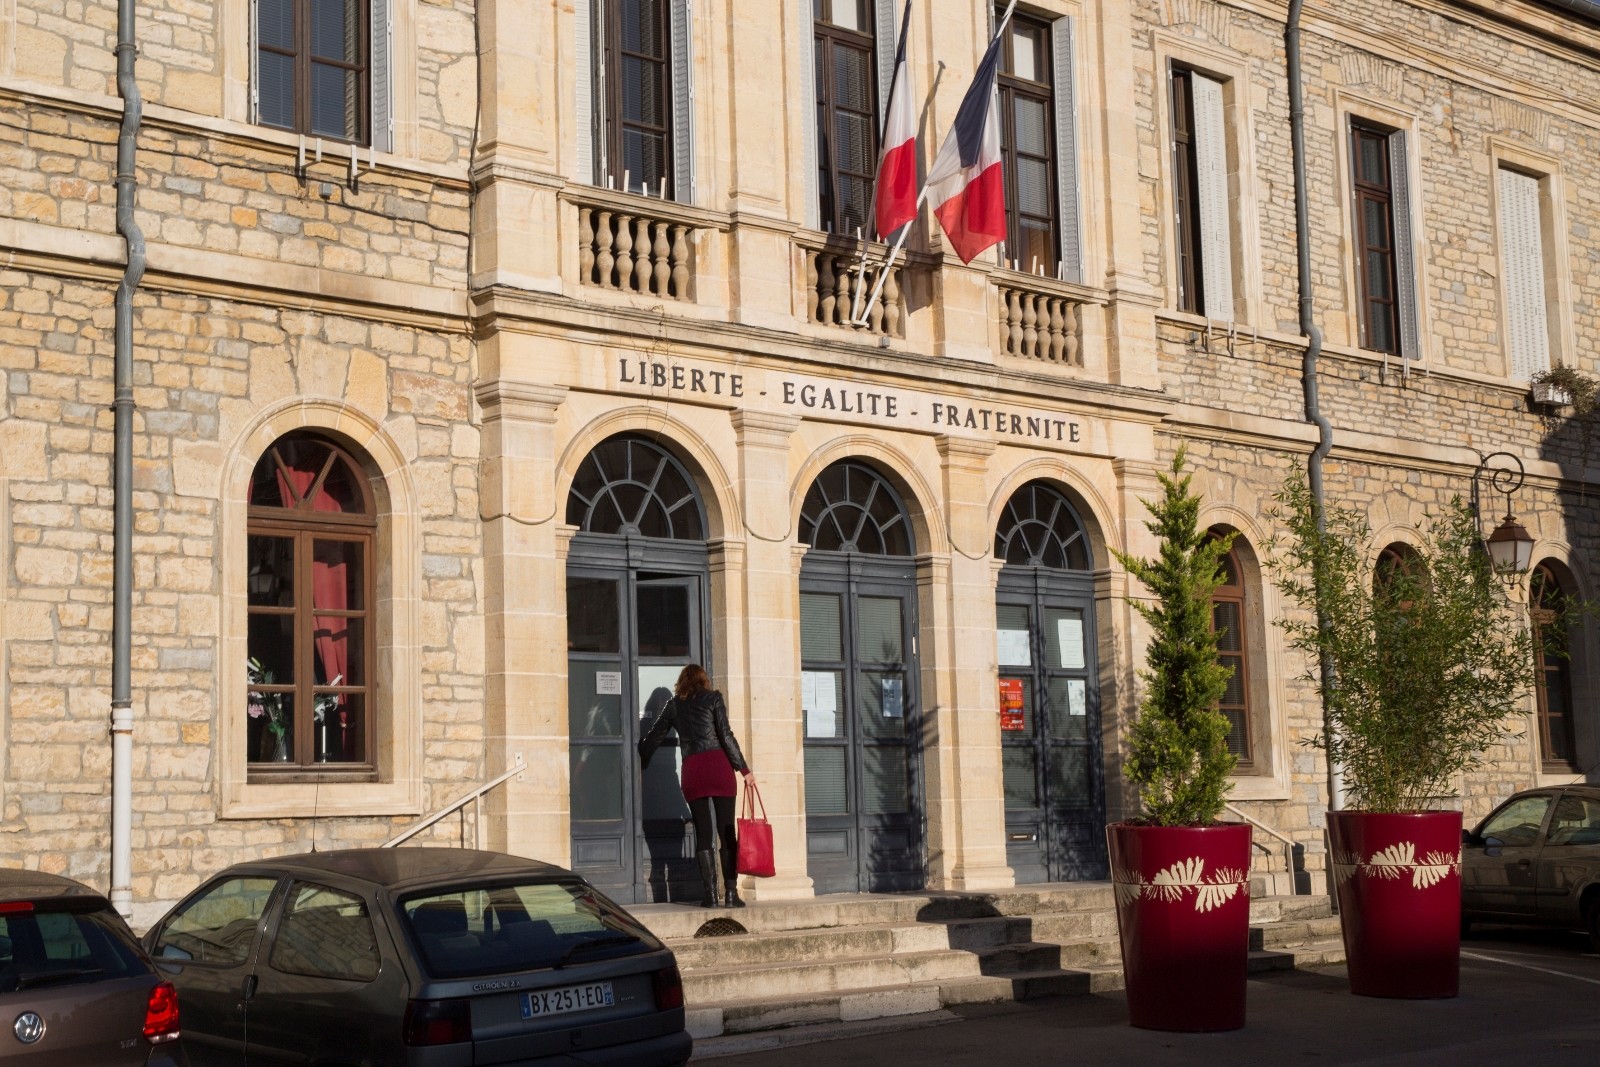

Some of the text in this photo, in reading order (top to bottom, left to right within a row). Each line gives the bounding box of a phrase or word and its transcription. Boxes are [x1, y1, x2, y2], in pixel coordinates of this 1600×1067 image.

[619, 358, 744, 398] LIBERTE
[782, 381, 898, 418] EGALITE
[932, 402, 1081, 443] FRATERNITE
